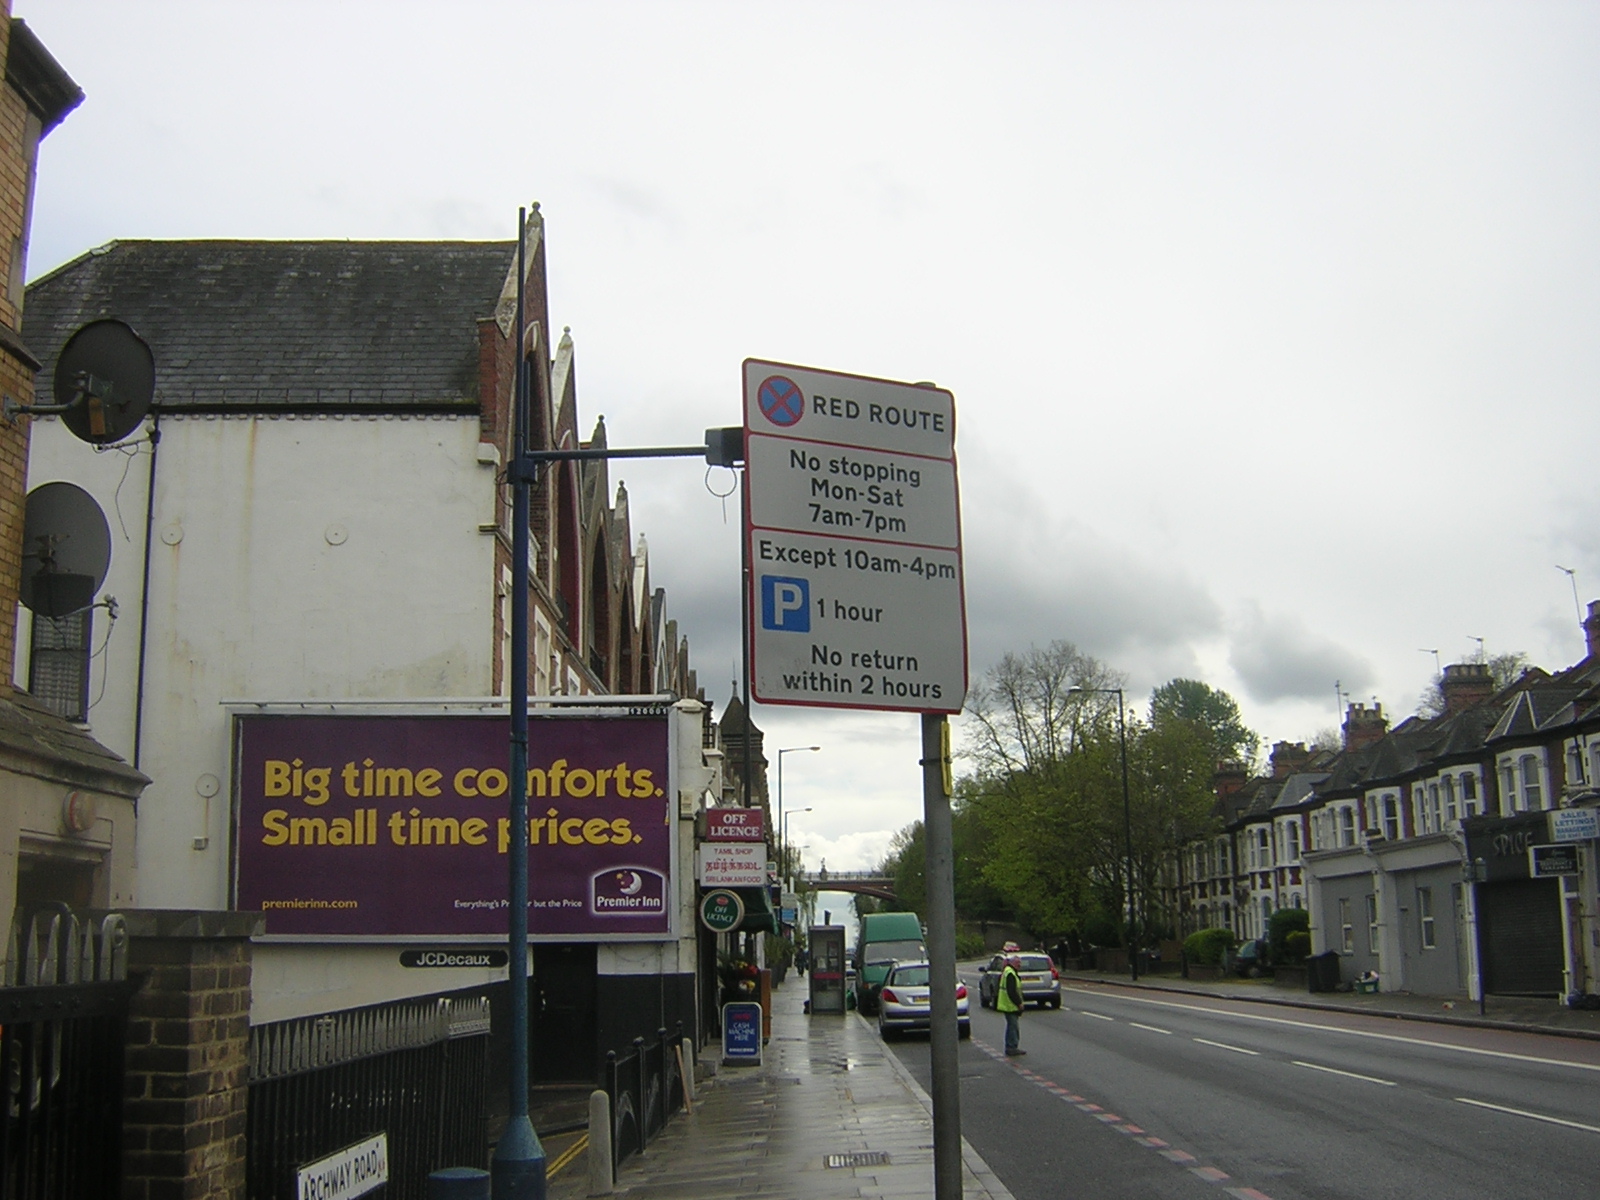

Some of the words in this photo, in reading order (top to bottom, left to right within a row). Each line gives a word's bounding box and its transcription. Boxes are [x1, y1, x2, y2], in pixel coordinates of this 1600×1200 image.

[813, 395, 860, 419] RED
[870, 404, 944, 432] ROUTE
[790, 449, 821, 471] No
[829, 457, 920, 488] stopping
[811, 478, 904, 508] Mon-Sat
[809, 503, 906, 534] 7am-7pm
[759, 541, 836, 569] Except
[845, 549, 956, 580] 10am-4pm
[774, 581, 803, 625] P
[817, 599, 825, 618] 1
[835, 600, 883, 623] hour
[811, 644, 842, 667] No
[851, 650, 918, 672] return
[783, 672, 852, 694] within
[861, 675, 874, 696] 2
[882, 677, 942, 699] hours
[264, 758, 332, 806] Big
[341, 757, 443, 797] time
[262, 808, 377, 846] Small
[388, 807, 488, 846] time
[723, 814, 747, 824] OFF
[1554, 817, 1596, 826] LETTINGS
[1561, 811, 1587, 819] SALES
[711, 826, 759, 837] LICENCE
[262, 898, 358, 910] premierinn.com
[533, 899, 547, 908] but
[547, 899, 561, 908] the
[562, 899, 583, 908] Price
[597, 896, 641, 908] Premier
[642, 896, 661, 907] Inn
[416, 952, 491, 966] JCDecaux
[304, 1160, 352, 1200] ARCHWAY
[354, 1149, 378, 1184] ROAD
